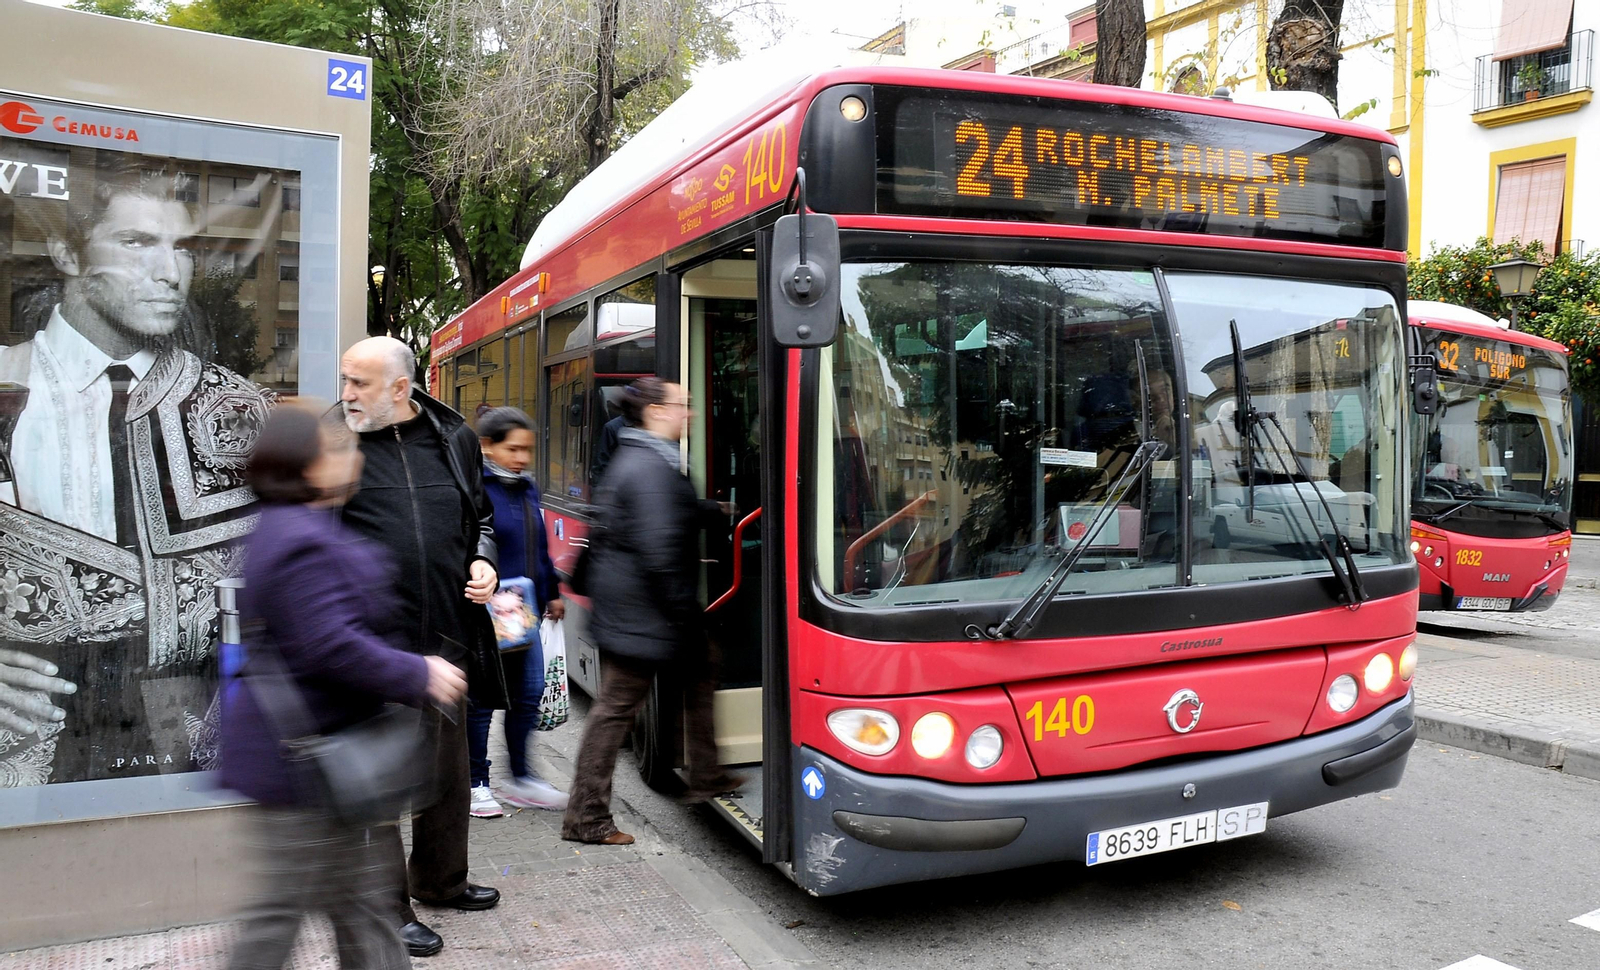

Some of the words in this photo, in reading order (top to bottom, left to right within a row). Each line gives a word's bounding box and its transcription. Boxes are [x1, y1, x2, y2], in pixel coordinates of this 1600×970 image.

[330, 66, 365, 94] 24
[52, 116, 139, 142] CEMUSA
[742, 121, 786, 206] 140
[955, 121, 1029, 199] 24
[1036, 129, 1309, 187] ROCHELAMBERT
[711, 190, 735, 212] TUSSAM
[1077, 170, 1112, 206] N.
[1133, 174, 1280, 219] PALMETE
[1439, 340, 1459, 371] 32
[1474, 347, 1526, 369] POLIGONO
[1490, 364, 1511, 380] SUR
[1455, 549, 1483, 567] 1832
[1482, 572, 1511, 582] MAN
[1462, 597, 1479, 608] 3344
[1161, 636, 1223, 653] Castrosua
[1025, 694, 1095, 743] 140
[116, 753, 173, 768] PARA
[1089, 850, 1096, 860] E
[1105, 826, 1159, 858] 8639
[1169, 816, 1209, 847] FLH
